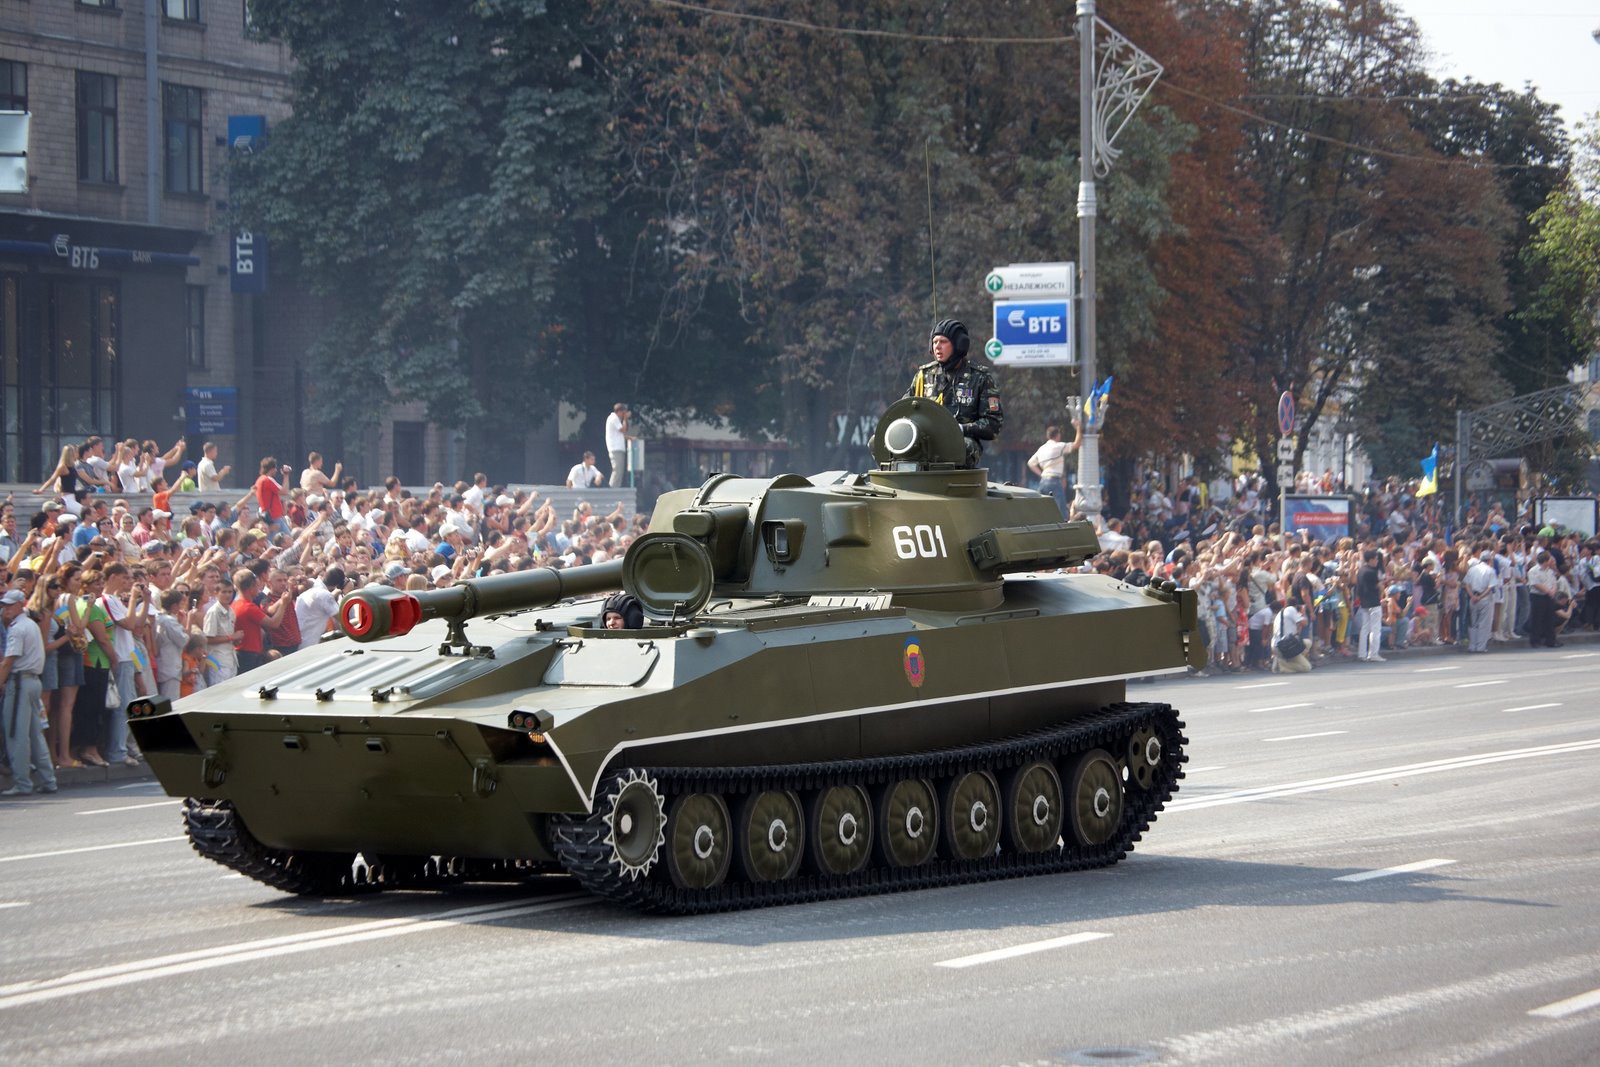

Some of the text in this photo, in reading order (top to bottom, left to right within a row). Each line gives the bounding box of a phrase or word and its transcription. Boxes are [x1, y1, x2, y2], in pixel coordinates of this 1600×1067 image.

[72, 246, 99, 269] ВТБ
[1028, 316, 1061, 333] ВТБ
[892, 524, 948, 559] 601
